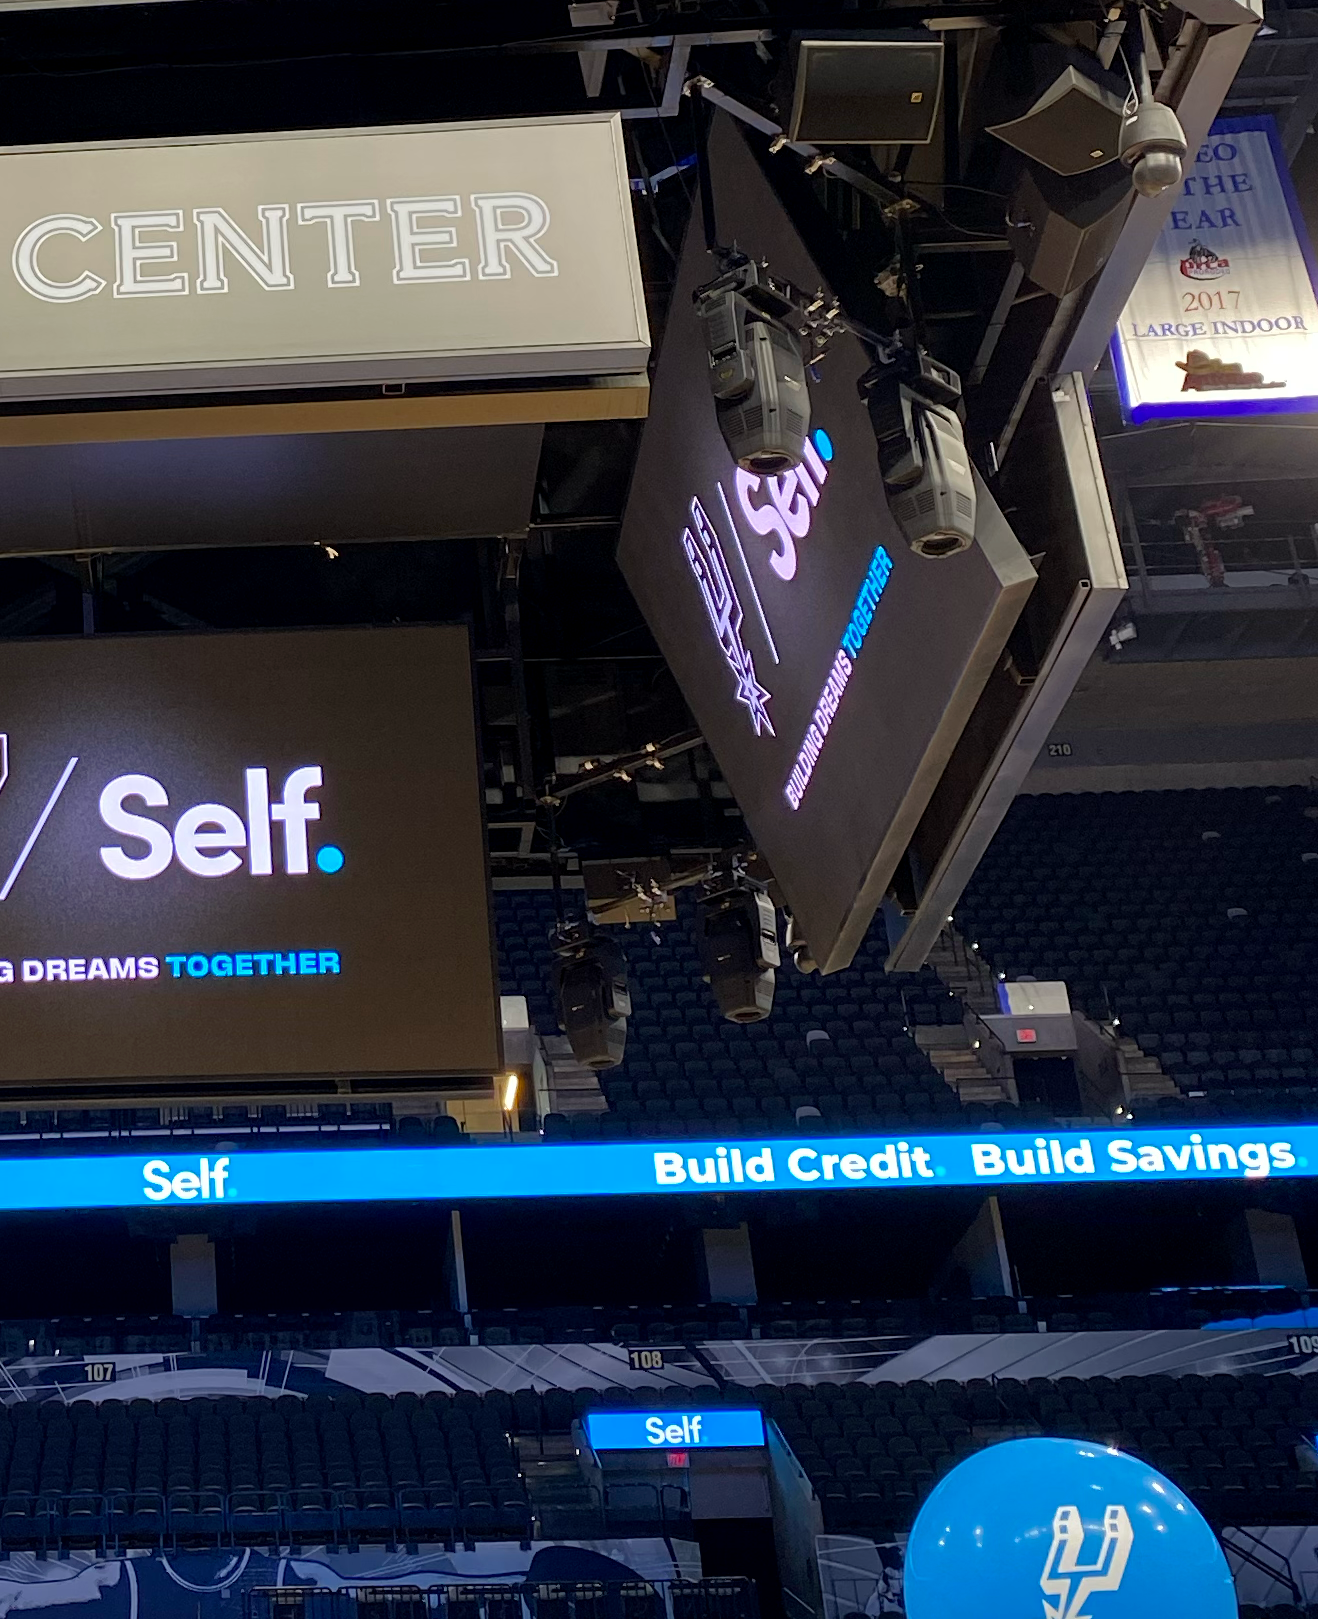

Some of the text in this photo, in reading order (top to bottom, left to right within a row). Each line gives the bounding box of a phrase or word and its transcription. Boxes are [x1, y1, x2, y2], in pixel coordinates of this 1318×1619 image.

[1183, 173, 1253, 196] THE
[11, 192, 560, 304] CENTER
[1182, 290, 1241, 312] 2017
[1132, 315, 1308, 337] LARGE INDOOR
[784, 545, 893, 811] BUILDING DREAMS TOGETHER
[1048, 743, 1072, 757] 210
[22, 956, 160, 983] DREAMS
[163, 948, 342, 979] TOGETHER
[653, 1146, 775, 1185] Build
[971, 1137, 1095, 1176] Build
[630, 1350, 663, 1370] 108
[84, 1363, 114, 1381] 107
